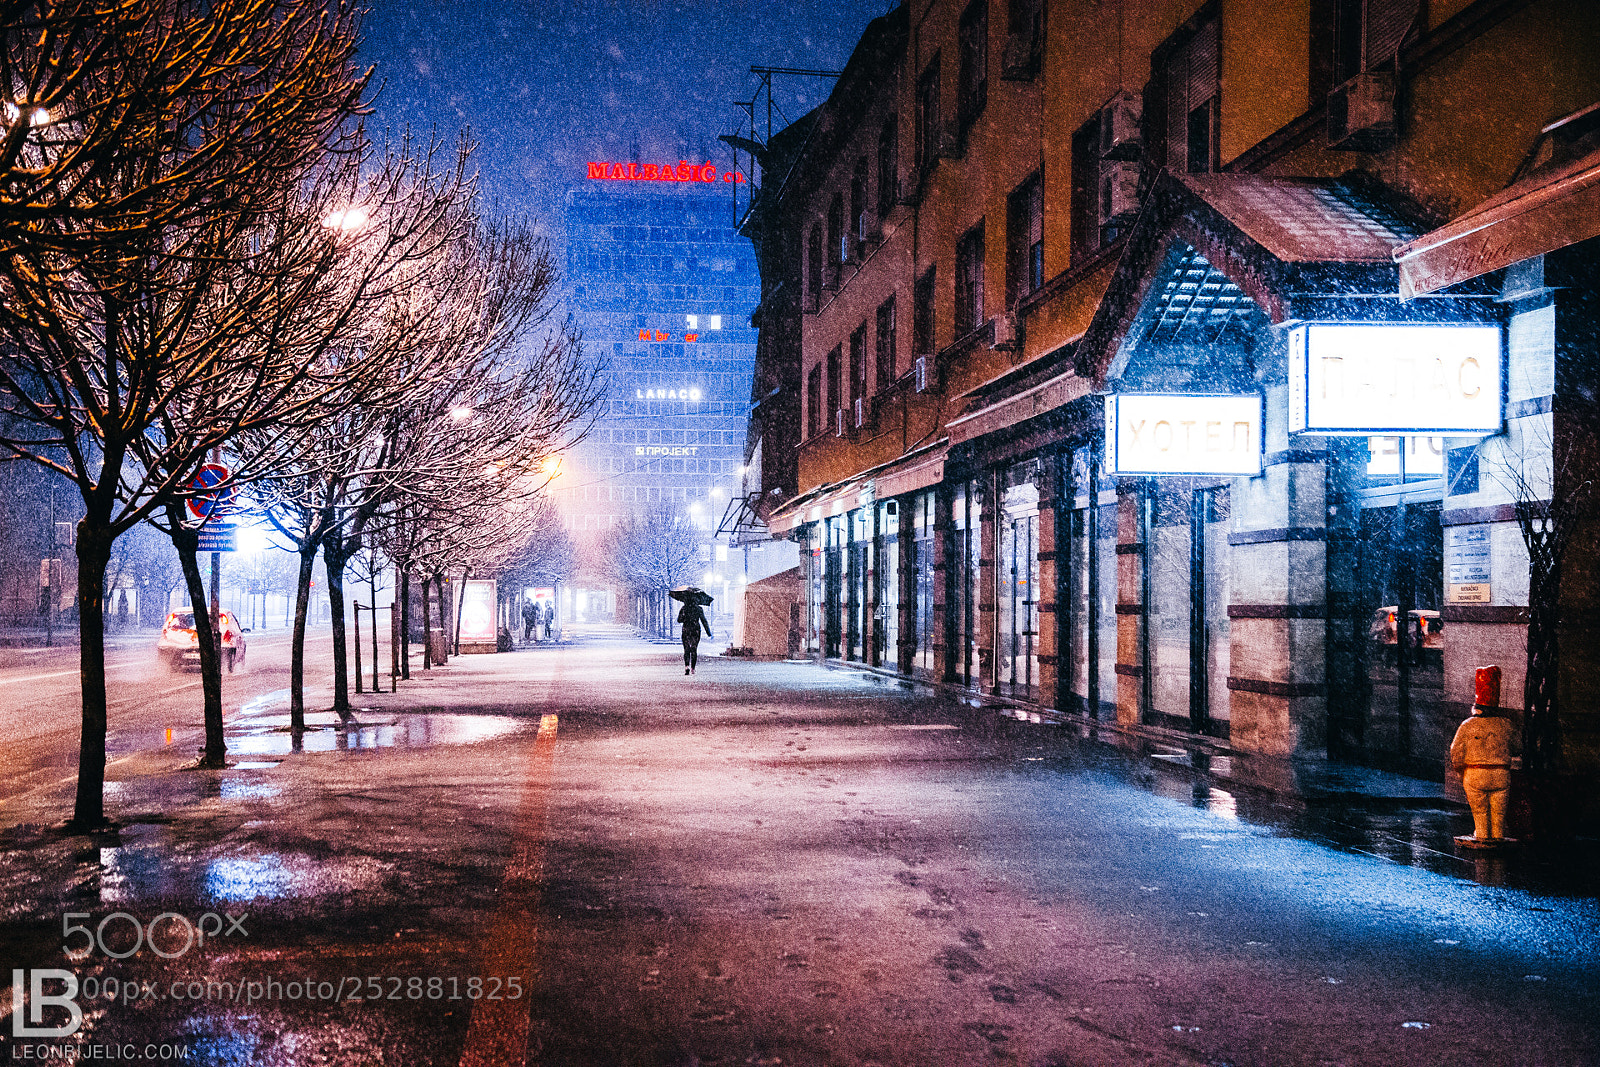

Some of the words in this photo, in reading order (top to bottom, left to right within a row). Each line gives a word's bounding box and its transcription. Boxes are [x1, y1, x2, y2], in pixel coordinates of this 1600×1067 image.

[587, 160, 717, 182] MALBAŠIĆ
[637, 388, 702, 400] LANACO
[1128, 419, 1251, 453] ХОТЕЛ
